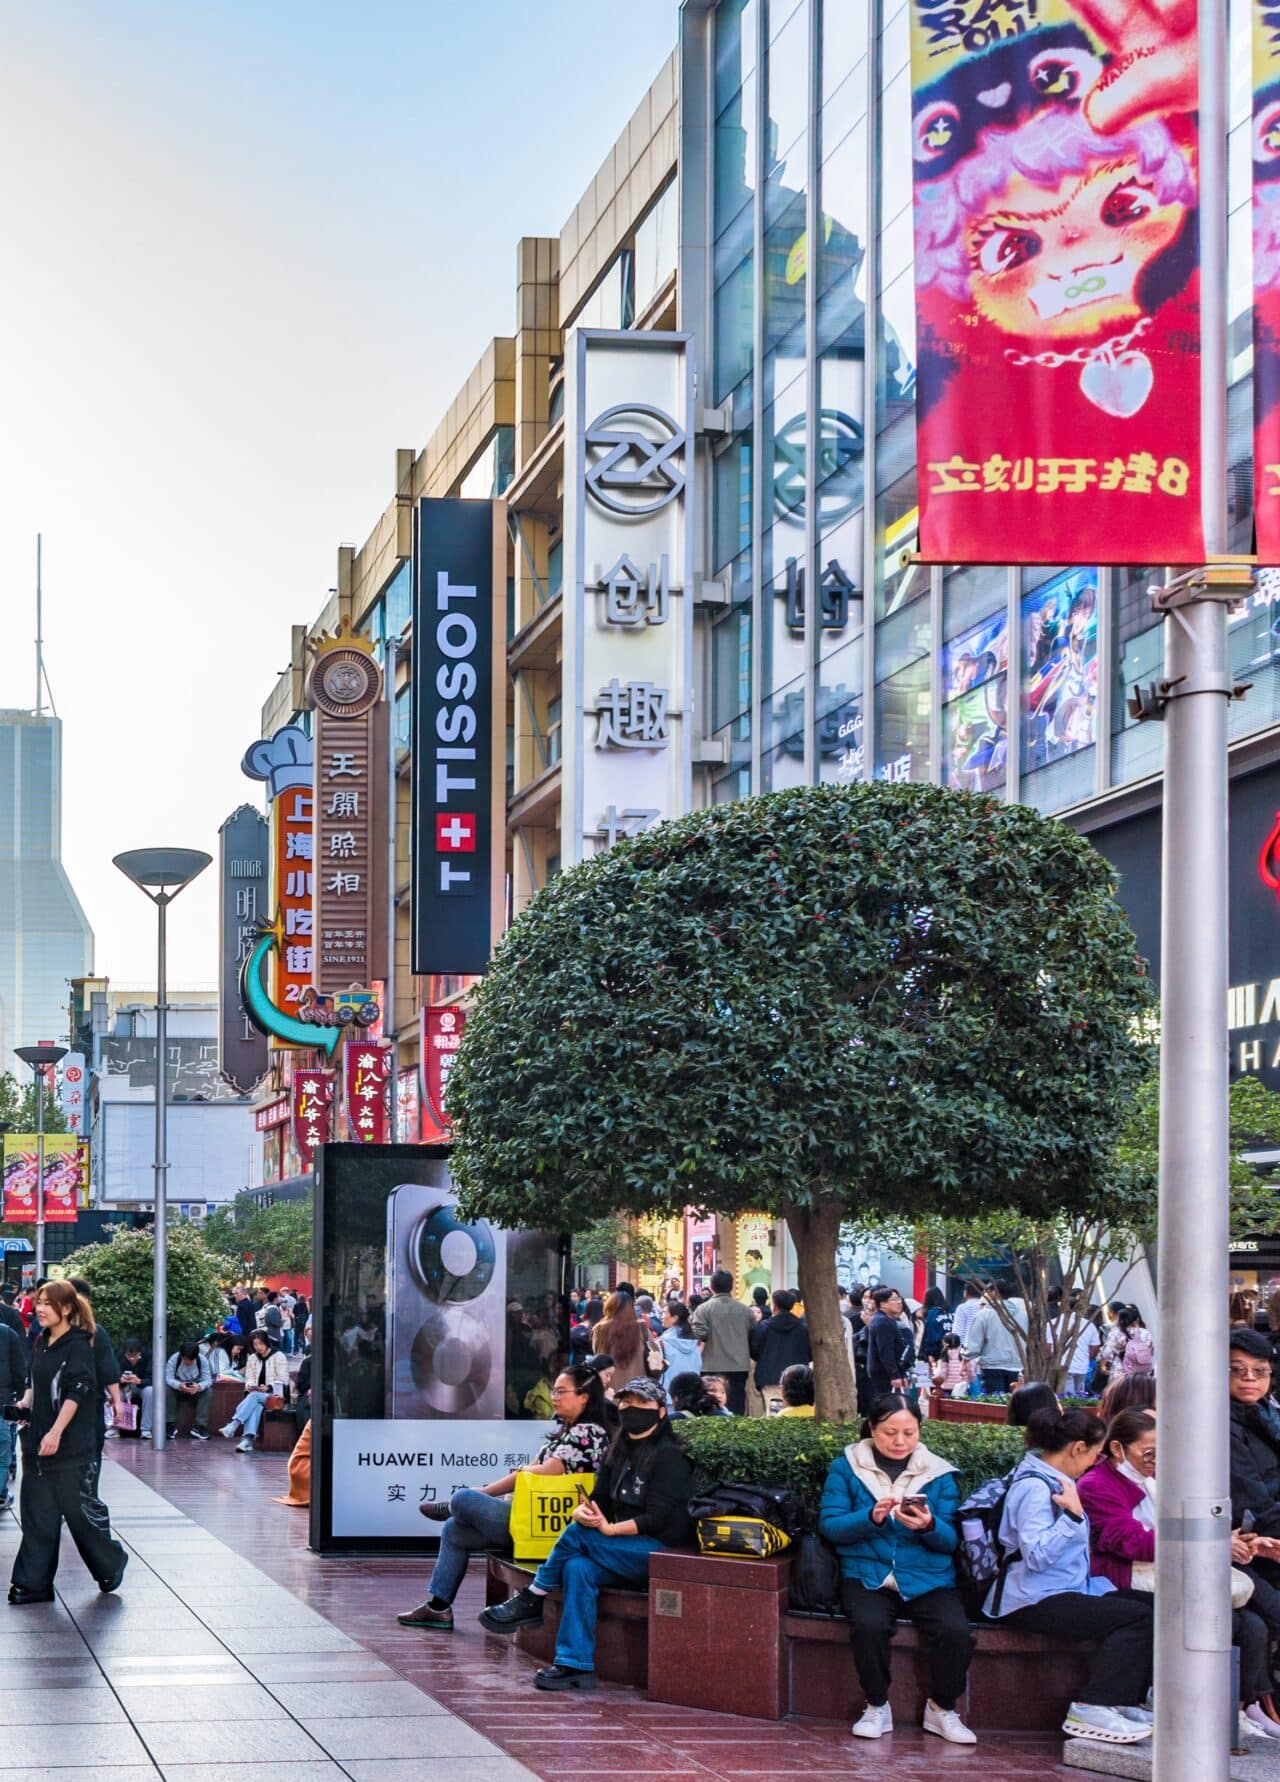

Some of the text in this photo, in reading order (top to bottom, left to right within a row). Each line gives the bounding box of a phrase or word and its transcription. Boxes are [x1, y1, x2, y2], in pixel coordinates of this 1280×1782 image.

[435, 571, 478, 804] TISSOT
[358, 1453, 530, 1467] HUAWEI Mate80 系列
[537, 1496, 573, 1514] TOP
